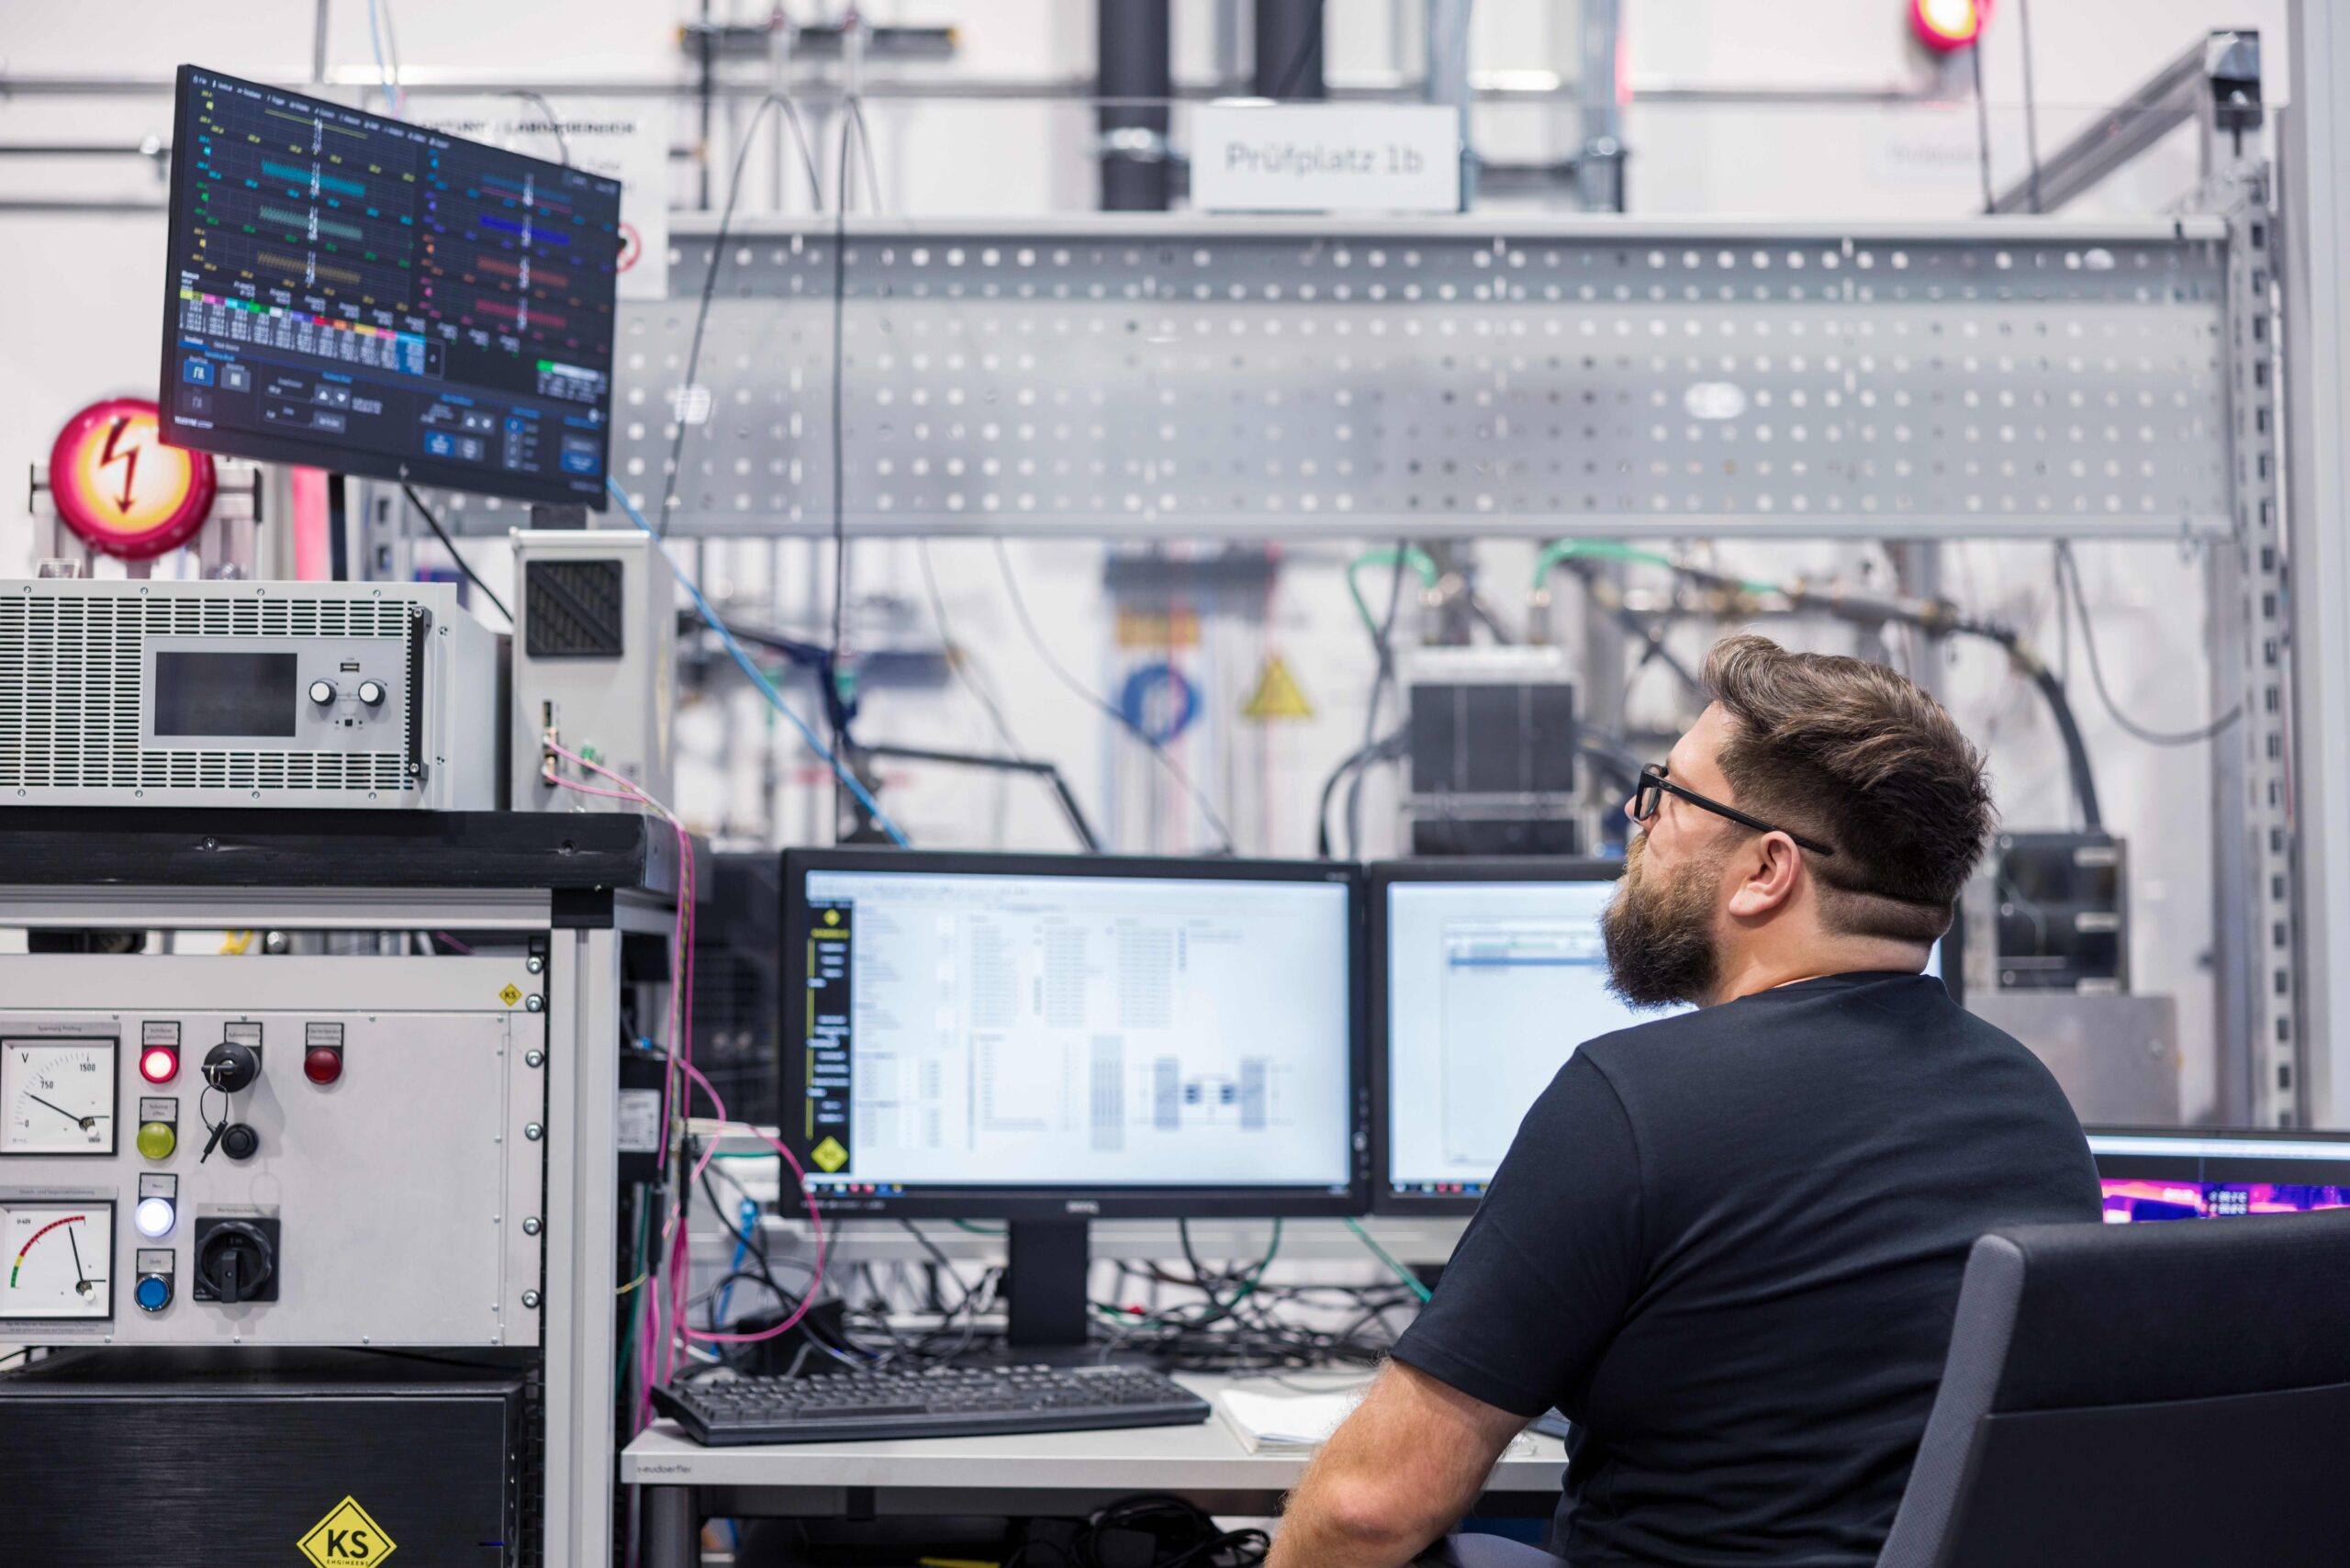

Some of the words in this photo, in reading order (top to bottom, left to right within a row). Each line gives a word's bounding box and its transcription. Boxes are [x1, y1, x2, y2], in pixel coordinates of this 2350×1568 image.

[1225, 141, 1375, 180] Prüfplatz
[1386, 143, 1424, 174] 1b
[21, 1053, 29, 1063] V
[79, 1063, 96, 1072] 1500
[40, 1081, 54, 1090] 750
[25, 1119, 29, 1128] 0
[327, 1529, 369, 1559] KS
